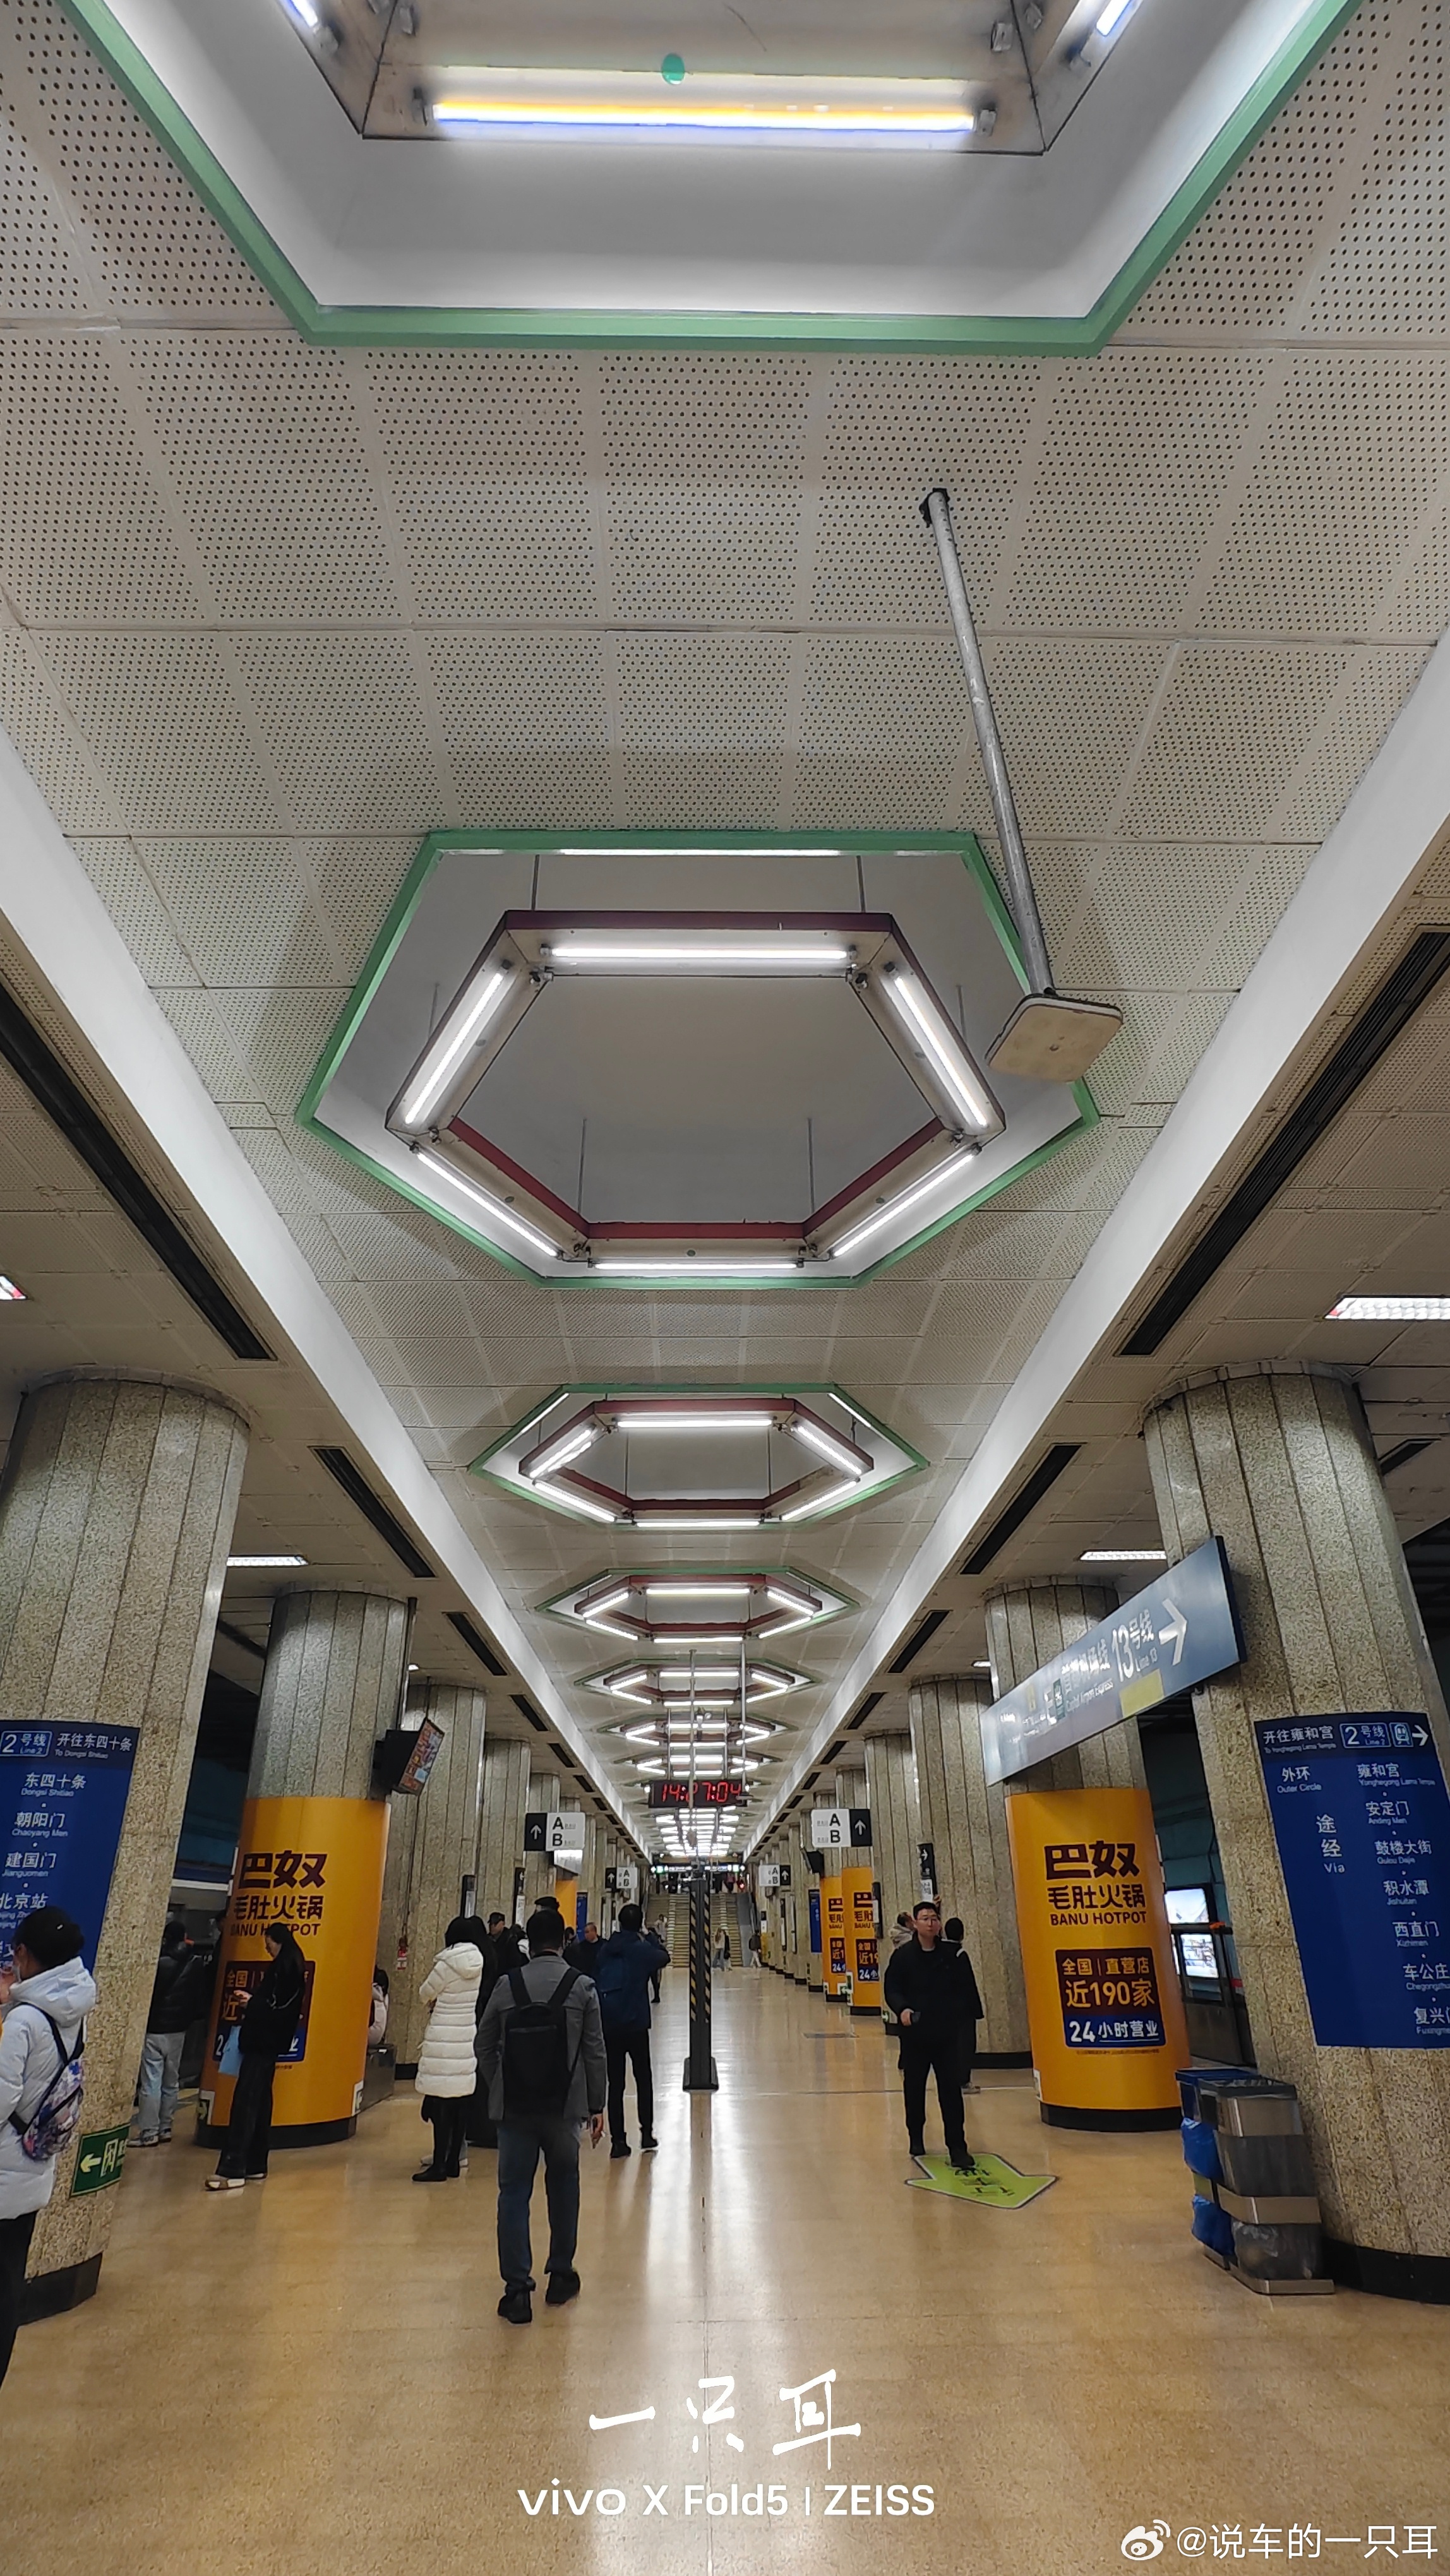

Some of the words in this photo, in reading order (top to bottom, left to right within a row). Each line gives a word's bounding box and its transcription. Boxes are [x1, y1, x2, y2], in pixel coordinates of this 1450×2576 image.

[57, 1733, 132, 1751] 开往东四十条
[1263, 1726, 1334, 1744] 开往雍和宫
[1281, 1766, 1310, 1782] 外环
[1357, 1762, 1400, 1779] 雍和宫
[24, 1772, 87, 1789] 东四十条
[1277, 1784, 1298, 1794] Outer
[1299, 1782, 1322, 1792] Circle
[1365, 1801, 1410, 1816] 安定门
[15, 1812, 65, 1828] 朝阳门
[553, 1817, 563, 1830] A
[830, 1813, 841, 1827] A
[553, 1834, 562, 1846] B
[830, 1830, 841, 1843] B
[1374, 1839, 1432, 1856] 鼓楼大街
[5, 1852, 57, 1868] 建国门
[1045, 1840, 1139, 1880] 巴奴
[1324, 1863, 1345, 1873] Via
[239, 1850, 327, 1888] 巴奴
[1383, 1880, 1430, 1896] 积水潭
[0, 1892, 49, 1909] 北京站
[854, 1892, 873, 1907] 巴
[1047, 1884, 1146, 1909] 毛肚火锅
[234, 1895, 323, 1920] 毛肚火锅
[829, 1898, 843, 1912] 巴
[1050, 1913, 1089, 1926] BANU
[1093, 1911, 1146, 1924] HOTPOT
[1392, 1921, 1439, 1937] 西直门
[1062, 1958, 1093, 1975] 全国
[1403, 1963, 1450, 1981] 车公庄
[1065, 1978, 1155, 2008] 近190家
